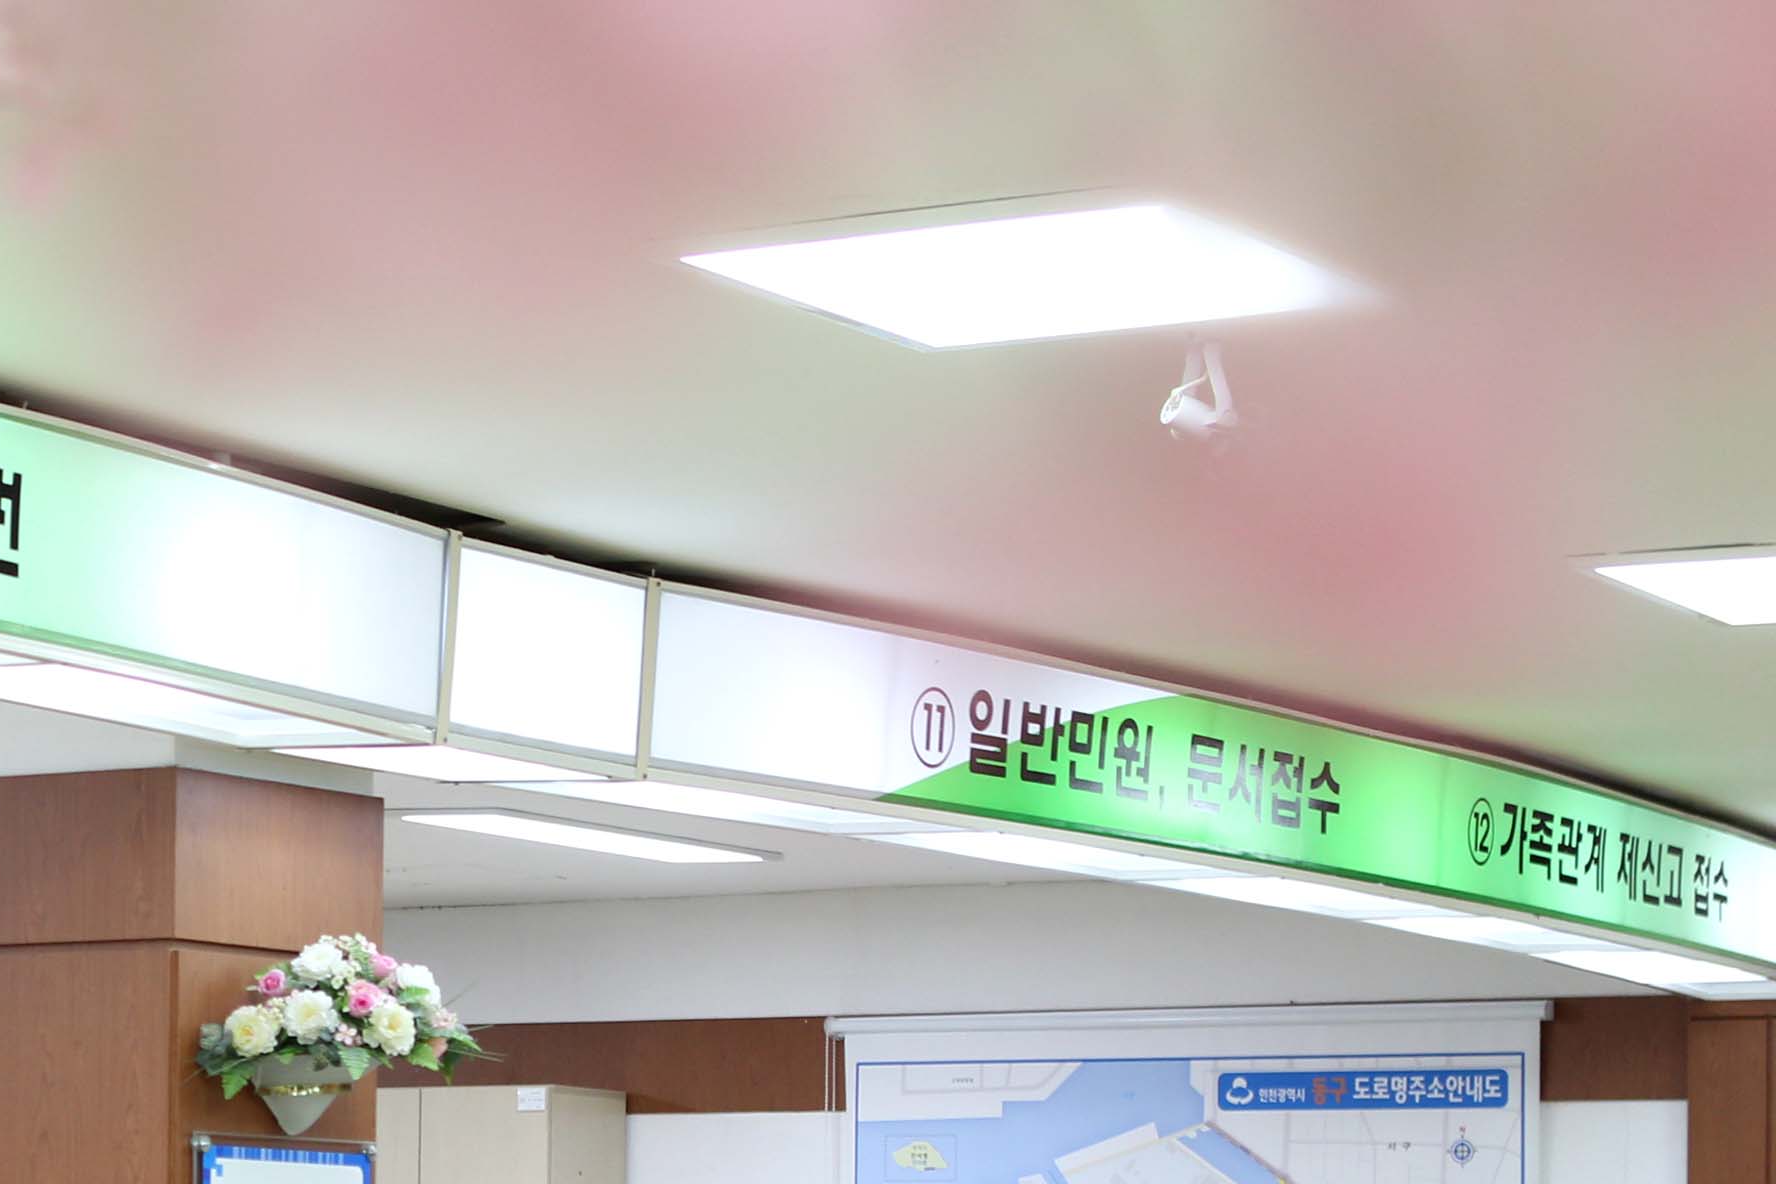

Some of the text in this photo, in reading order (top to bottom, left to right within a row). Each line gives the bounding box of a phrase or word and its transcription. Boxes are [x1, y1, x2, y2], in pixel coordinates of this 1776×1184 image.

[968, 688, 1167, 812] 일반민원,
[1187, 733, 1342, 835] 문서접수
[1500, 802, 1607, 894] 가족관계
[1616, 831, 1684, 908] 제신고
[1691, 853, 1730, 923] 접수
[1257, 1074, 1502, 1105] 인천광역시 동구 도로명주소안내도
